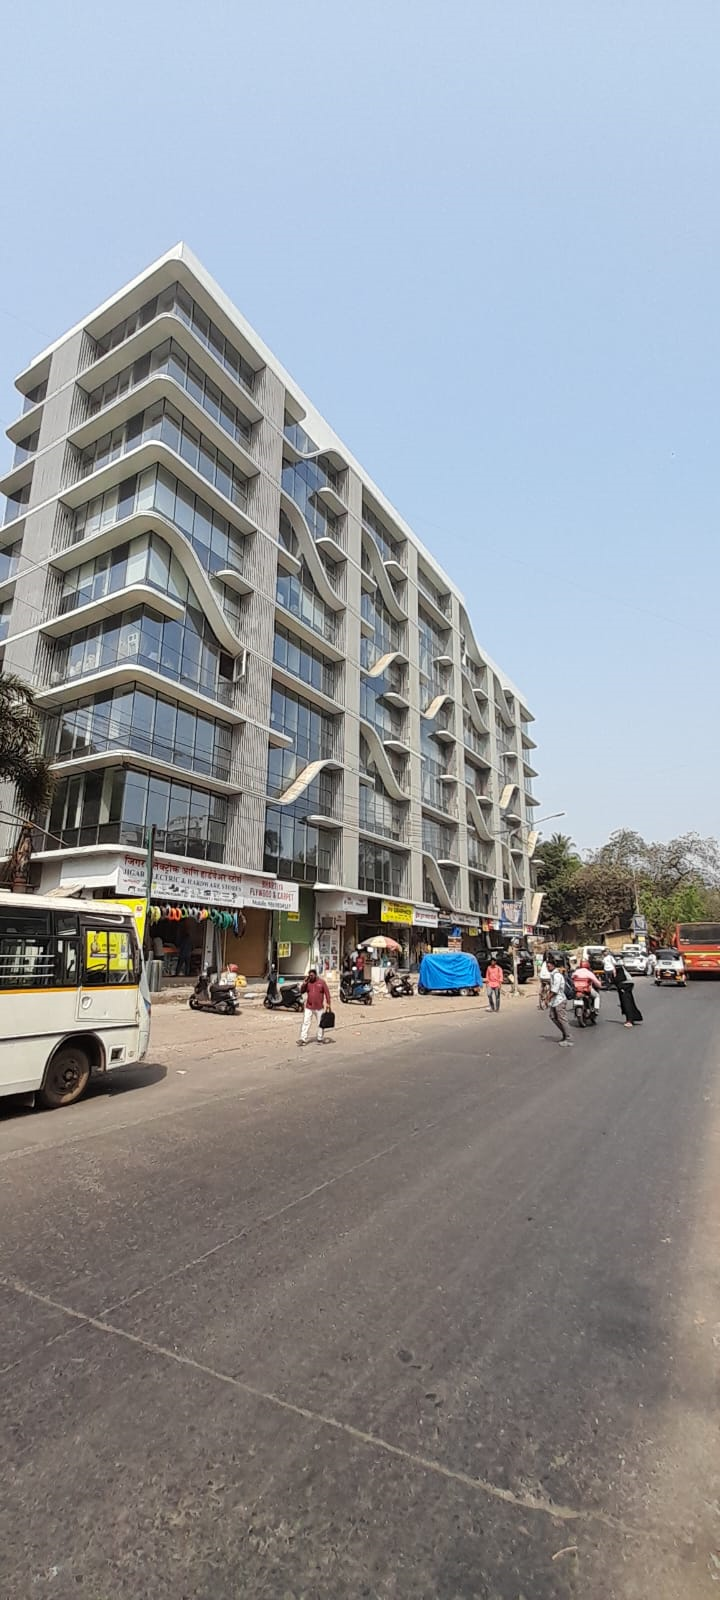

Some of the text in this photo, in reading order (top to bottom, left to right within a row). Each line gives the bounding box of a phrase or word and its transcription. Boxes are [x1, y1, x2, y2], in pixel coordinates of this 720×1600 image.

[123, 868, 145, 878] JIGAR
[187, 878, 220, 889] HARDWARE
[221, 883, 242, 892] STORES
[250, 888, 272, 898] PLYWOOD
[277, 892, 294, 902] CARPET
